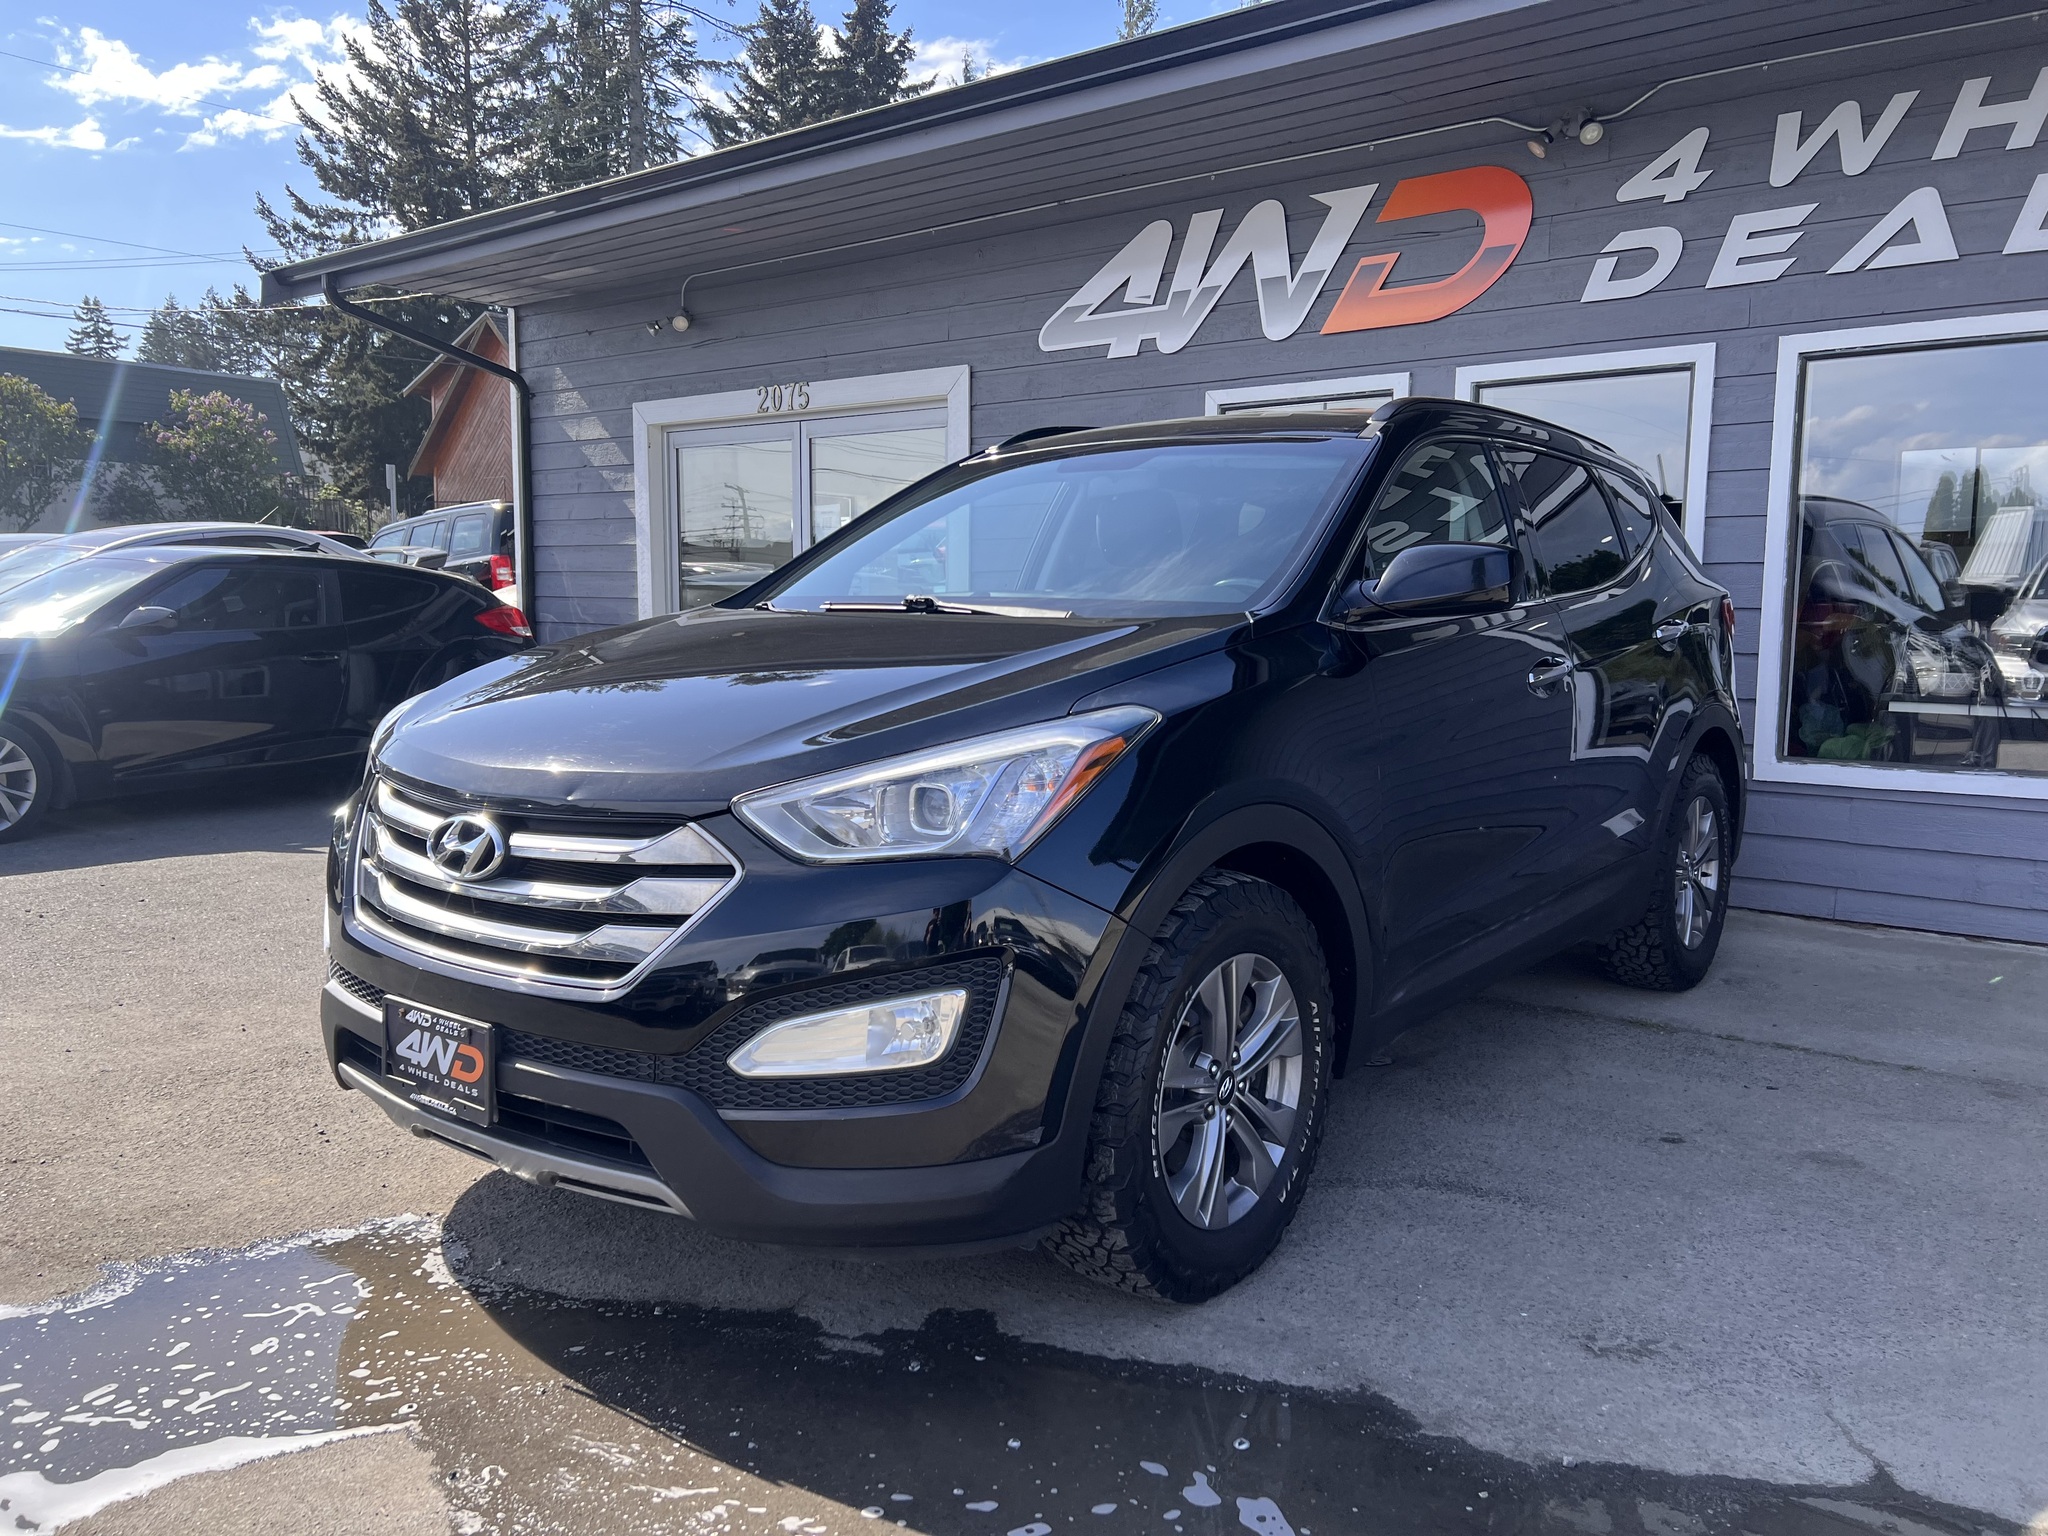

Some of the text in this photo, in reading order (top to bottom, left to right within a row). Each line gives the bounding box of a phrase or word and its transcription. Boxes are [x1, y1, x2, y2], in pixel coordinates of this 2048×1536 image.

[1616, 66, 2048, 203] 4 WH
[1038, 165, 1534, 359] 4WD
[757, 381, 810, 413] 2075
[396, 1029, 484, 1083] 4WD
[407, 1065, 440, 1083] WHEEL
[443, 1082, 479, 1097] DEALS
[1300, 1000, 1322, 1153] All-Terrain
